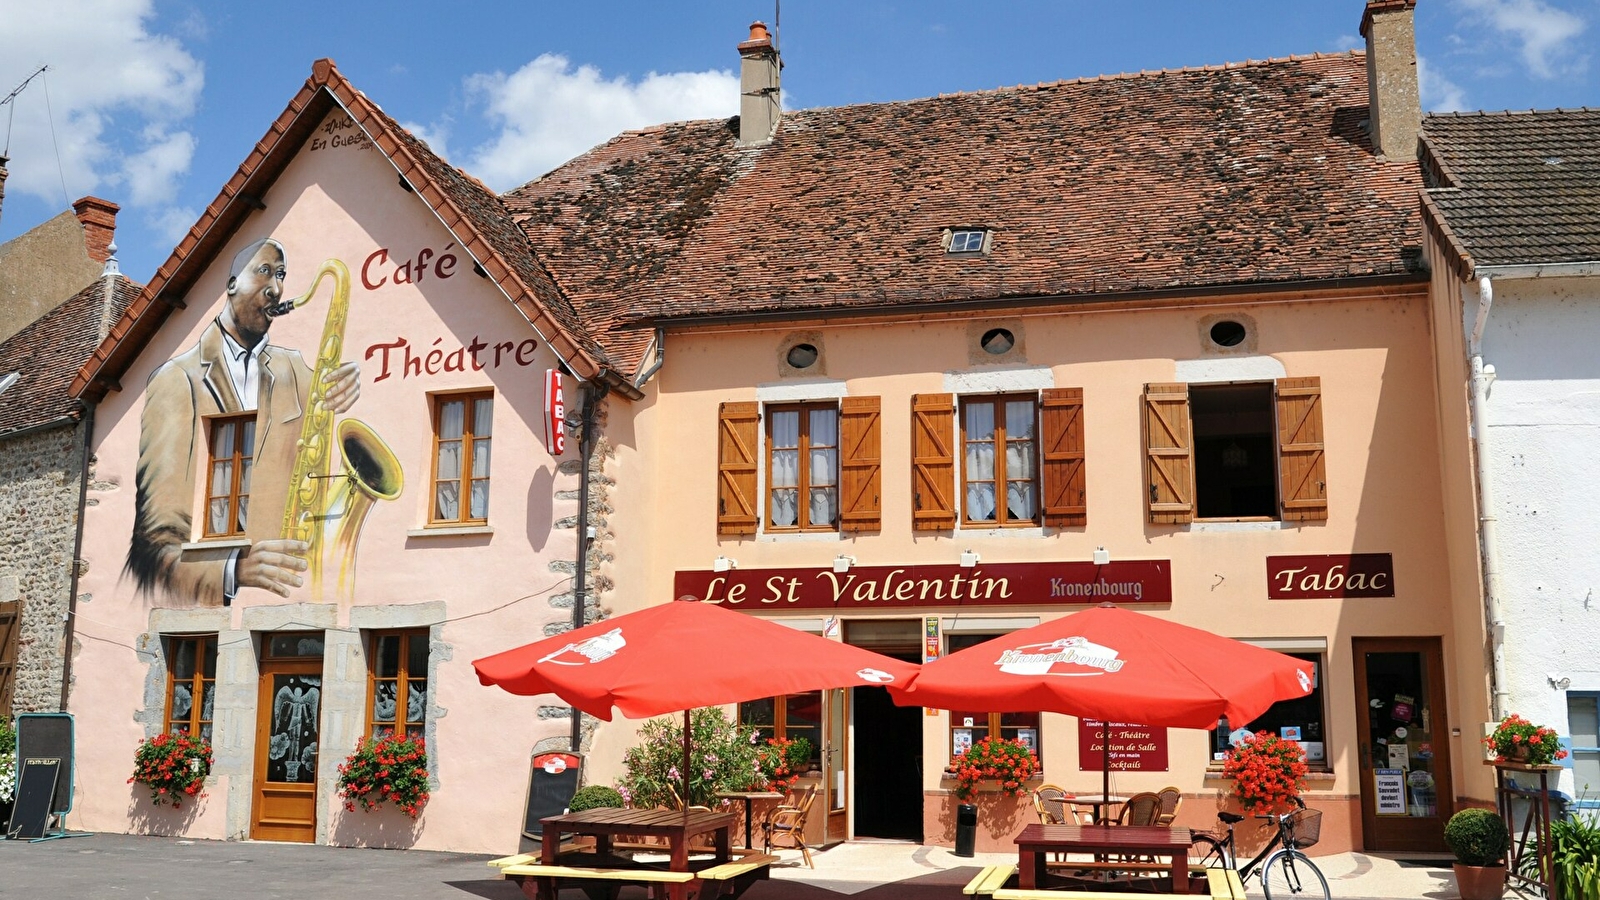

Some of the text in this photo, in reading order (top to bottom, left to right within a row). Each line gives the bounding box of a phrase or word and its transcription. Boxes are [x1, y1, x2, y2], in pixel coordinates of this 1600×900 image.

[310, 138, 327, 152] En
[361, 242, 458, 291] Café
[365, 335, 538, 383] Théatre
[554, 372, 565, 451] TABAC
[703, 569, 1142, 604] Le St Valentin Kronenbourg
[1274, 564, 1387, 592] Tabac
[997, 649, 1124, 671] Kronenbourg
[1090, 743, 1157, 751] Loction de Salle
[1095, 731, 1113, 739] Caé
